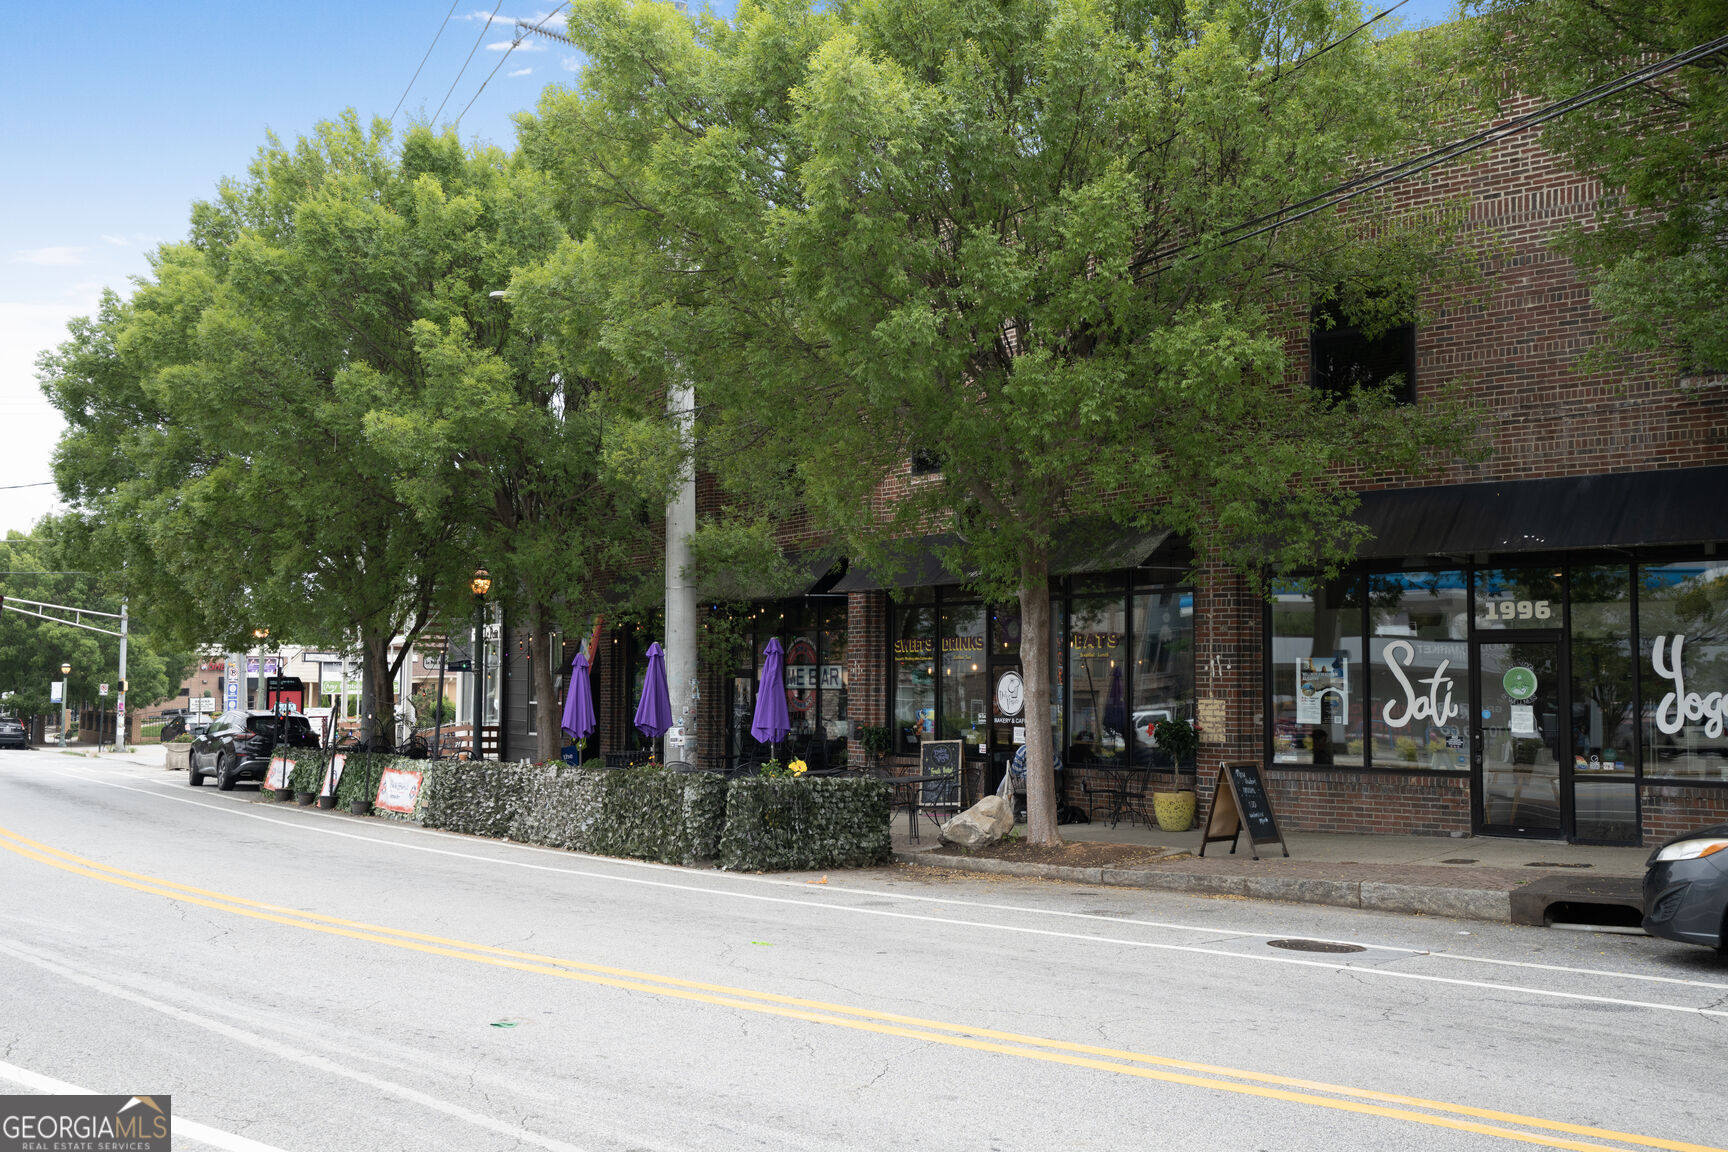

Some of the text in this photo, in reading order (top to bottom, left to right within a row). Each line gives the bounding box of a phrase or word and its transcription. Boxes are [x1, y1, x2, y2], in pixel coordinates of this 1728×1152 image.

[1485, 601, 1551, 620] 1996
[895, 638, 933, 653] SWEETS
[942, 636, 984, 652] DRINKS
[1074, 632, 1119, 649] EATS
[809, 667, 839, 686] BAR
[1383, 640, 1458, 728] Sati
